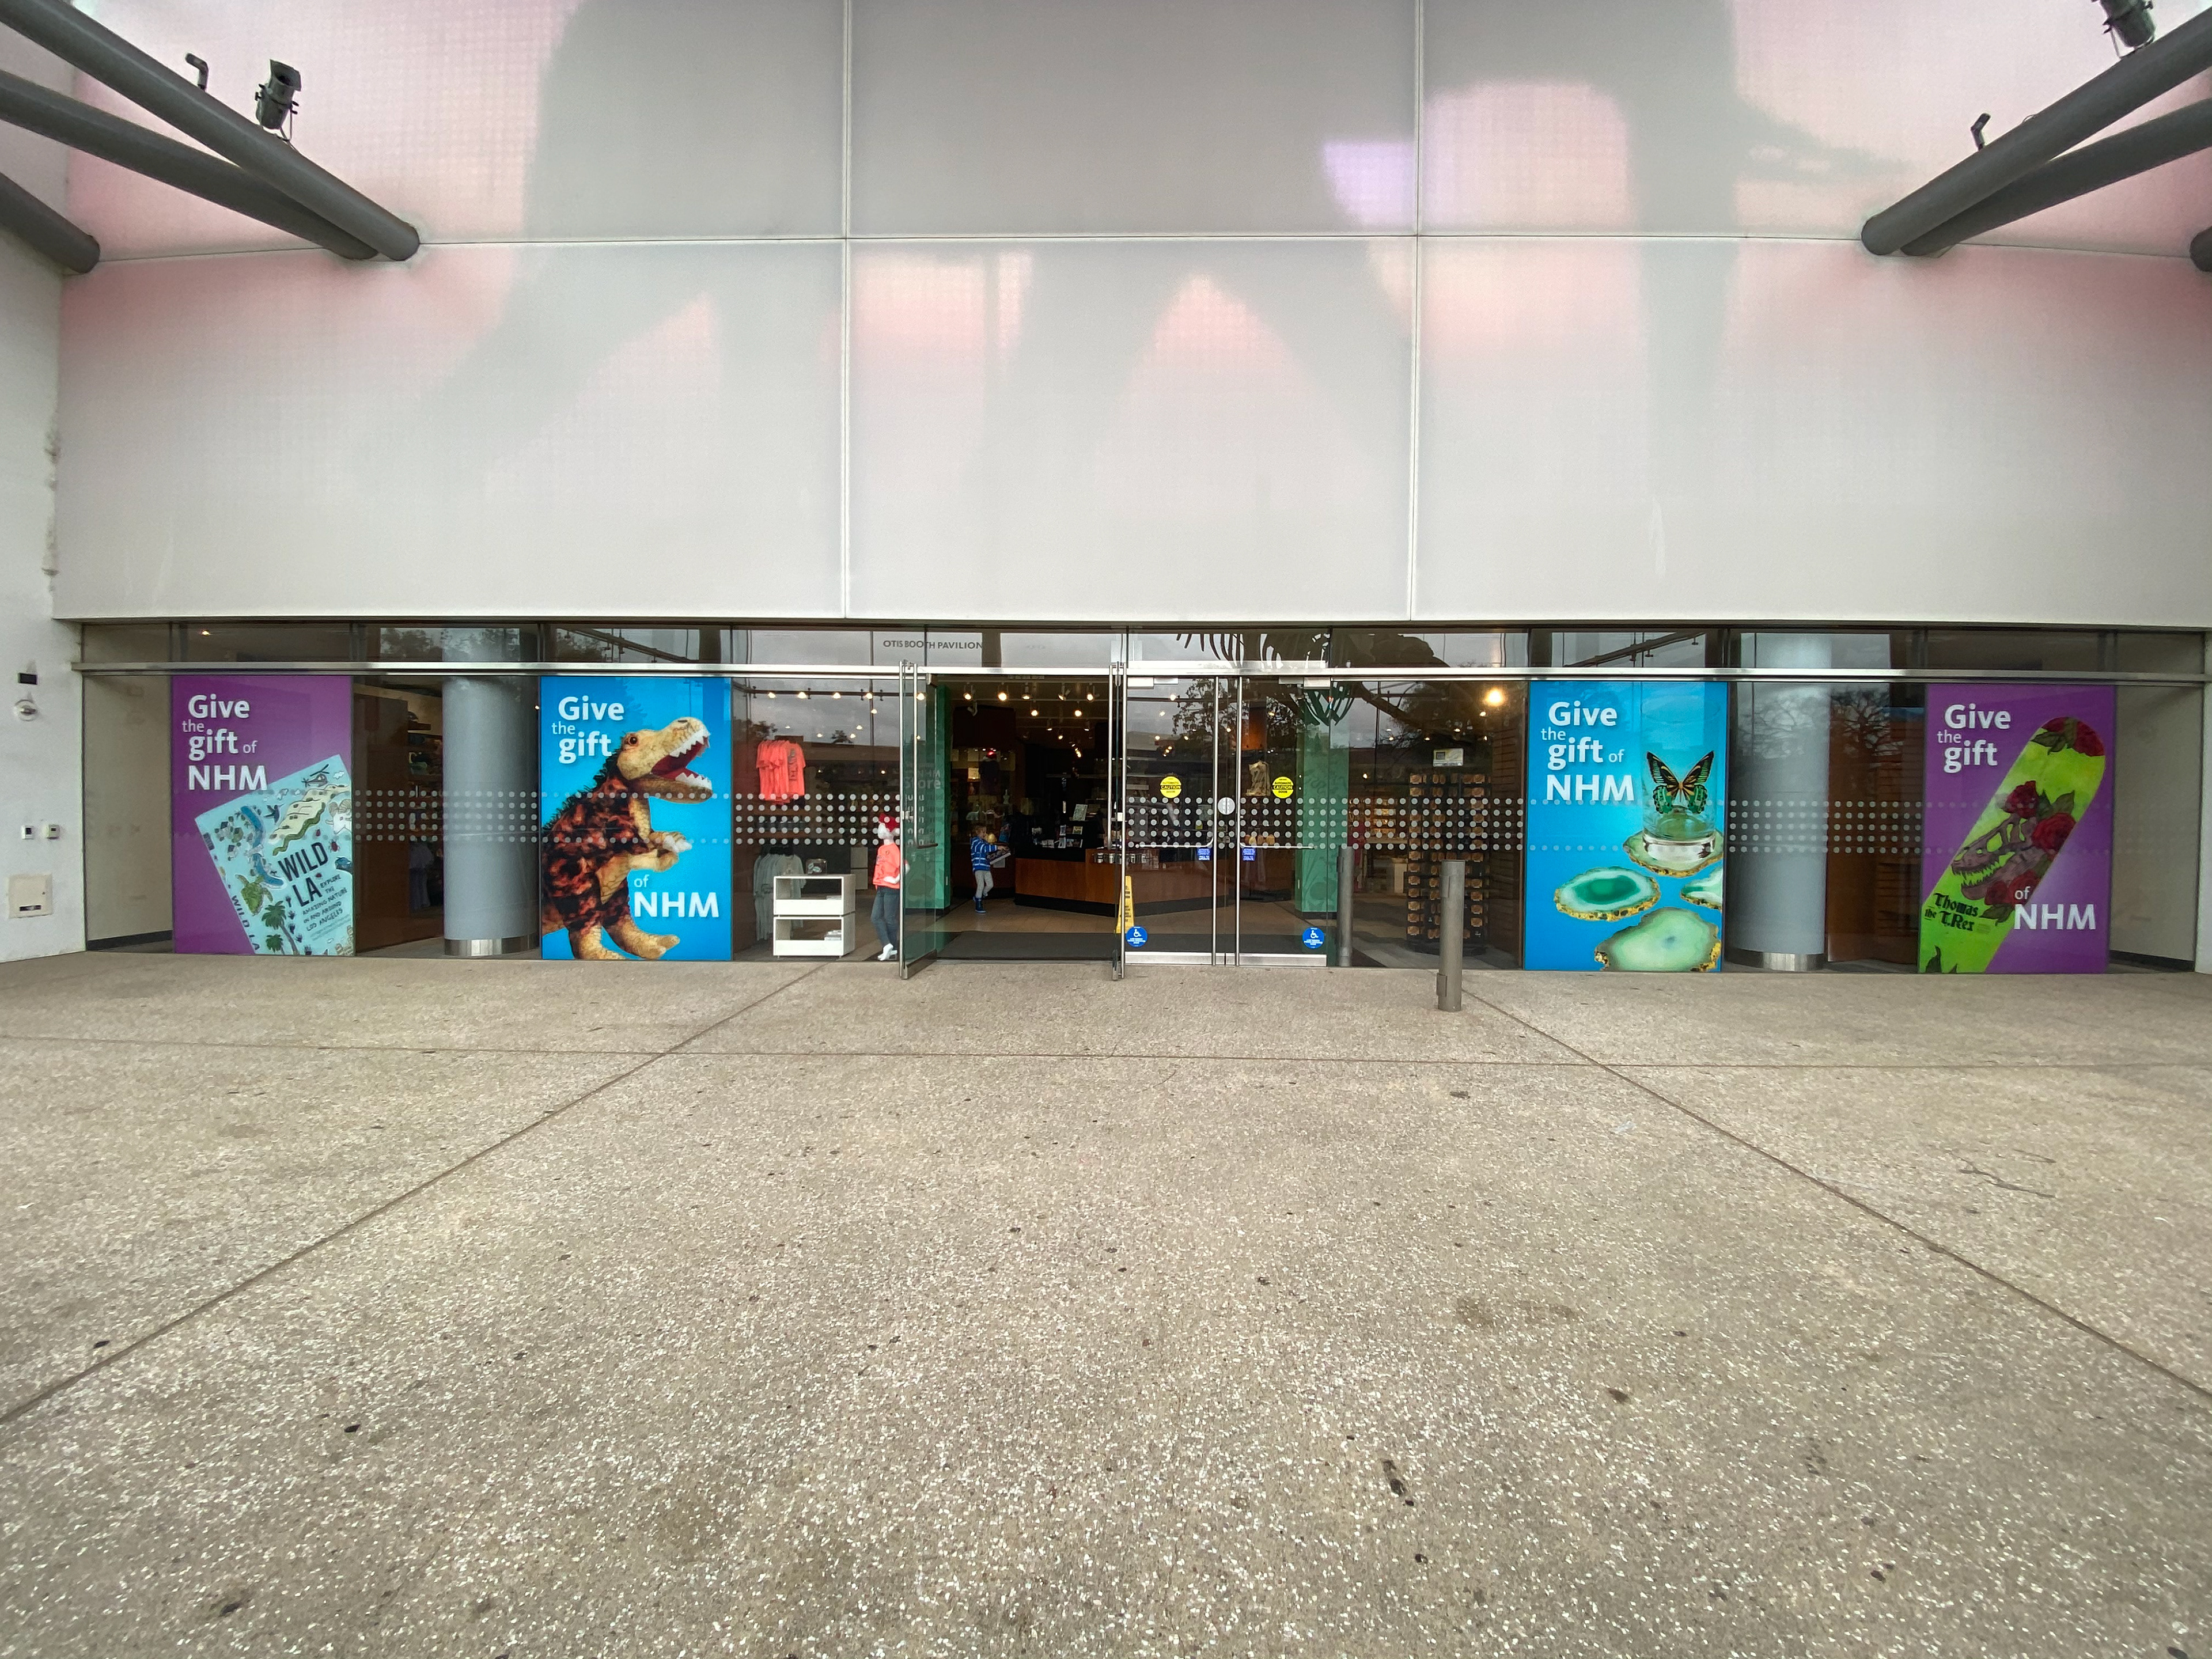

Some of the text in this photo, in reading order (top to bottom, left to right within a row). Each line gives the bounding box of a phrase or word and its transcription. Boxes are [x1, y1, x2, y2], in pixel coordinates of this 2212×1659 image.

[904, 640, 935, 649] BOOTH
[937, 641, 983, 649] PAVILION
[188, 694, 250, 718] Give
[558, 695, 624, 721] Give
[1548, 700, 1618, 726] Give
[1944, 703, 2011, 729] Give
[182, 719, 204, 733] the
[552, 721, 575, 734] the
[1540, 726, 1566, 741] the
[1937, 729, 1962, 743] the
[188, 729, 258, 761] gift of
[559, 731, 612, 764] gift
[1547, 737, 1625, 771] gift of
[1944, 740, 1998, 773] gift
[188, 765, 267, 791] NHM
[1547, 774, 1634, 801] NHM
[278, 842, 328, 882] WILD
[292, 877, 323, 907] LA
[320, 874, 342, 888] EXPLORE
[325, 886, 335, 894] THE
[634, 874, 650, 888] of
[2014, 886, 2031, 900] of
[232, 895, 250, 927] WILD
[302, 887, 347, 915] AMAZING NATURE
[309, 911, 321, 921] AND
[321, 901, 342, 916] AROUND
[634, 892, 719, 918] NHM
[306, 923, 317, 931] LOS
[319, 908, 343, 926] ANGELES
[2014, 904, 2096, 930] NHM
